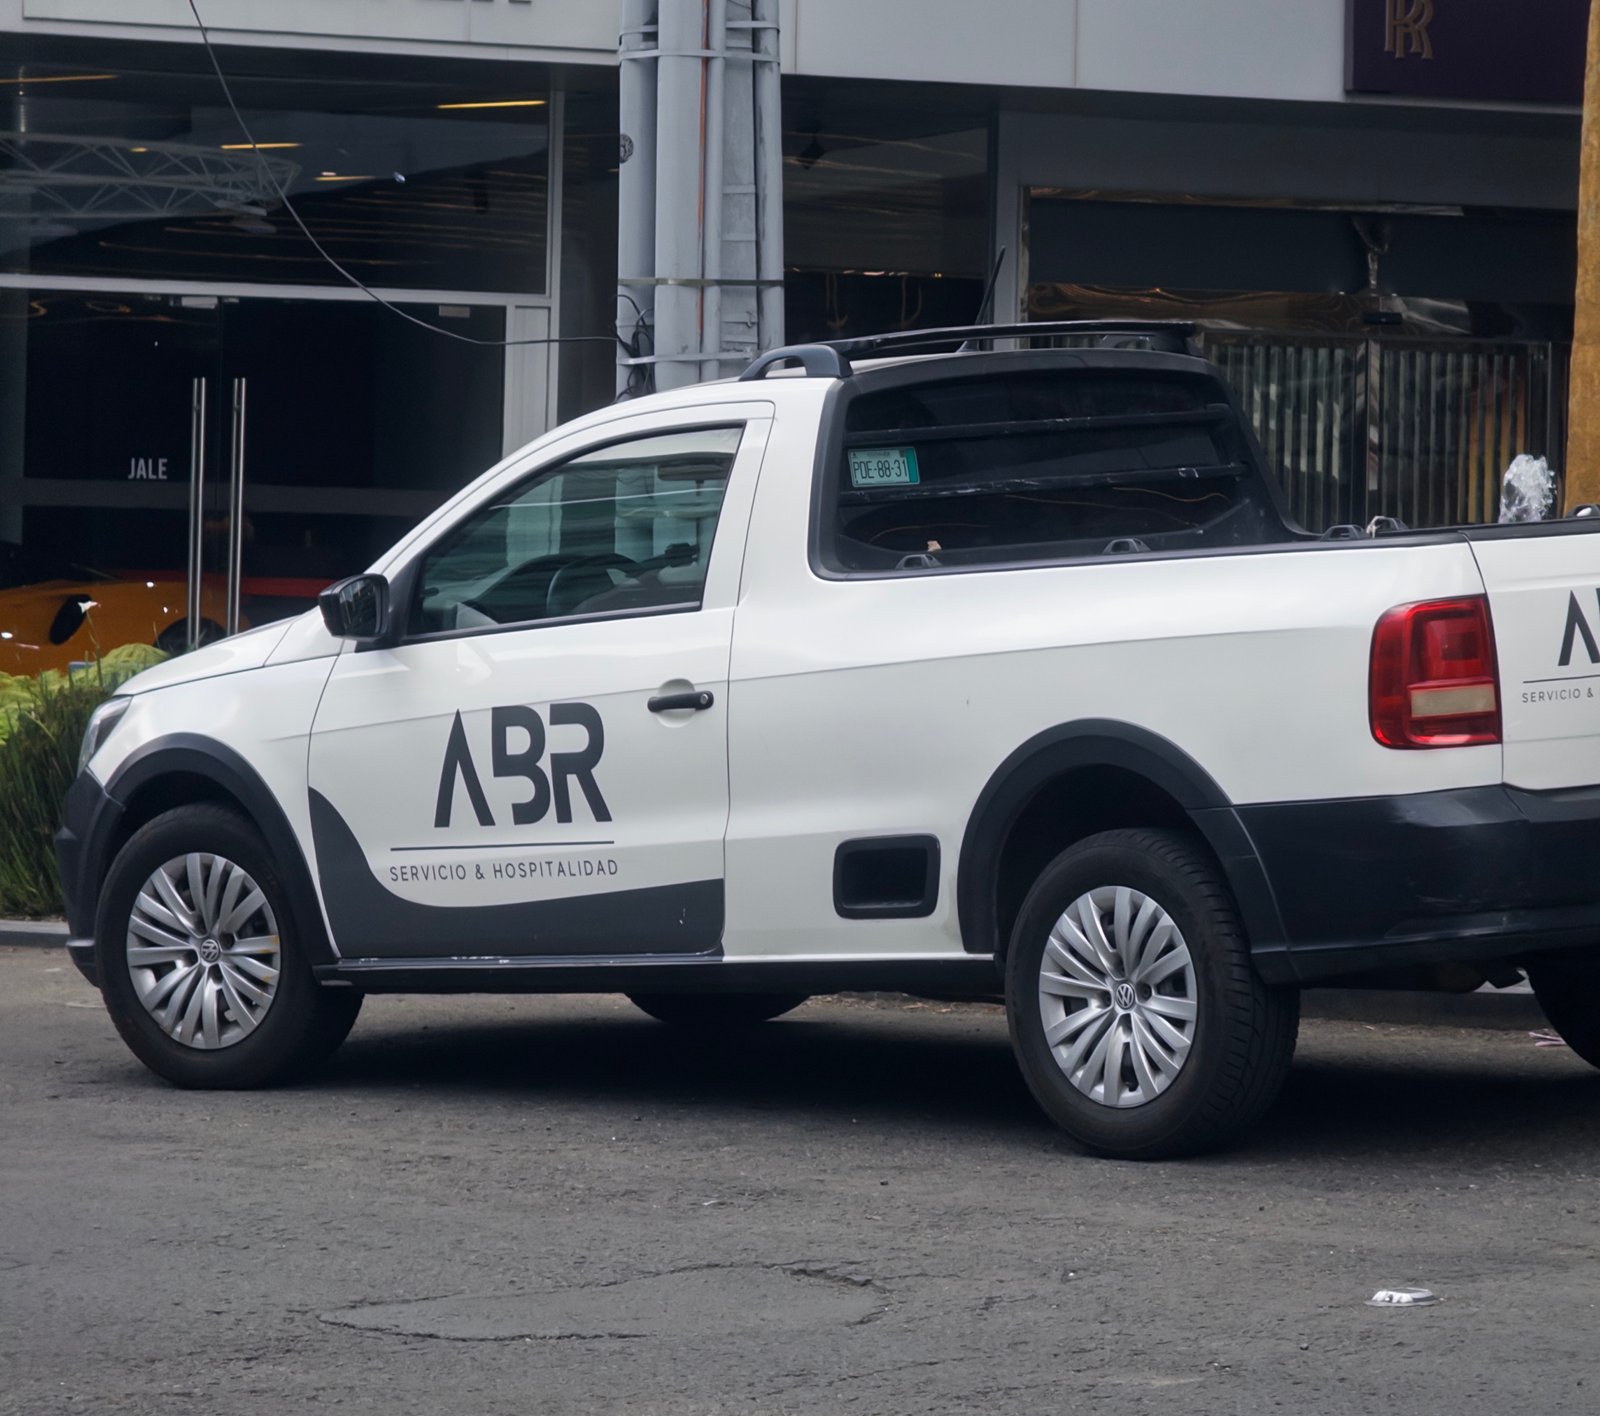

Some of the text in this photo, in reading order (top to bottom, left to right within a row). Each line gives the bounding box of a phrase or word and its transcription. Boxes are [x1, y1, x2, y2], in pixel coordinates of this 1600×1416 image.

[128, 457, 168, 480] JALE
[852, 459, 908, 479] PDE-88-31
[1558, 587, 1600, 666] A
[1522, 687, 1594, 703] SERVICIO &
[434, 702, 612, 828] ABR
[390, 859, 618, 882] SERVICIO & HOSPITALIDAD
